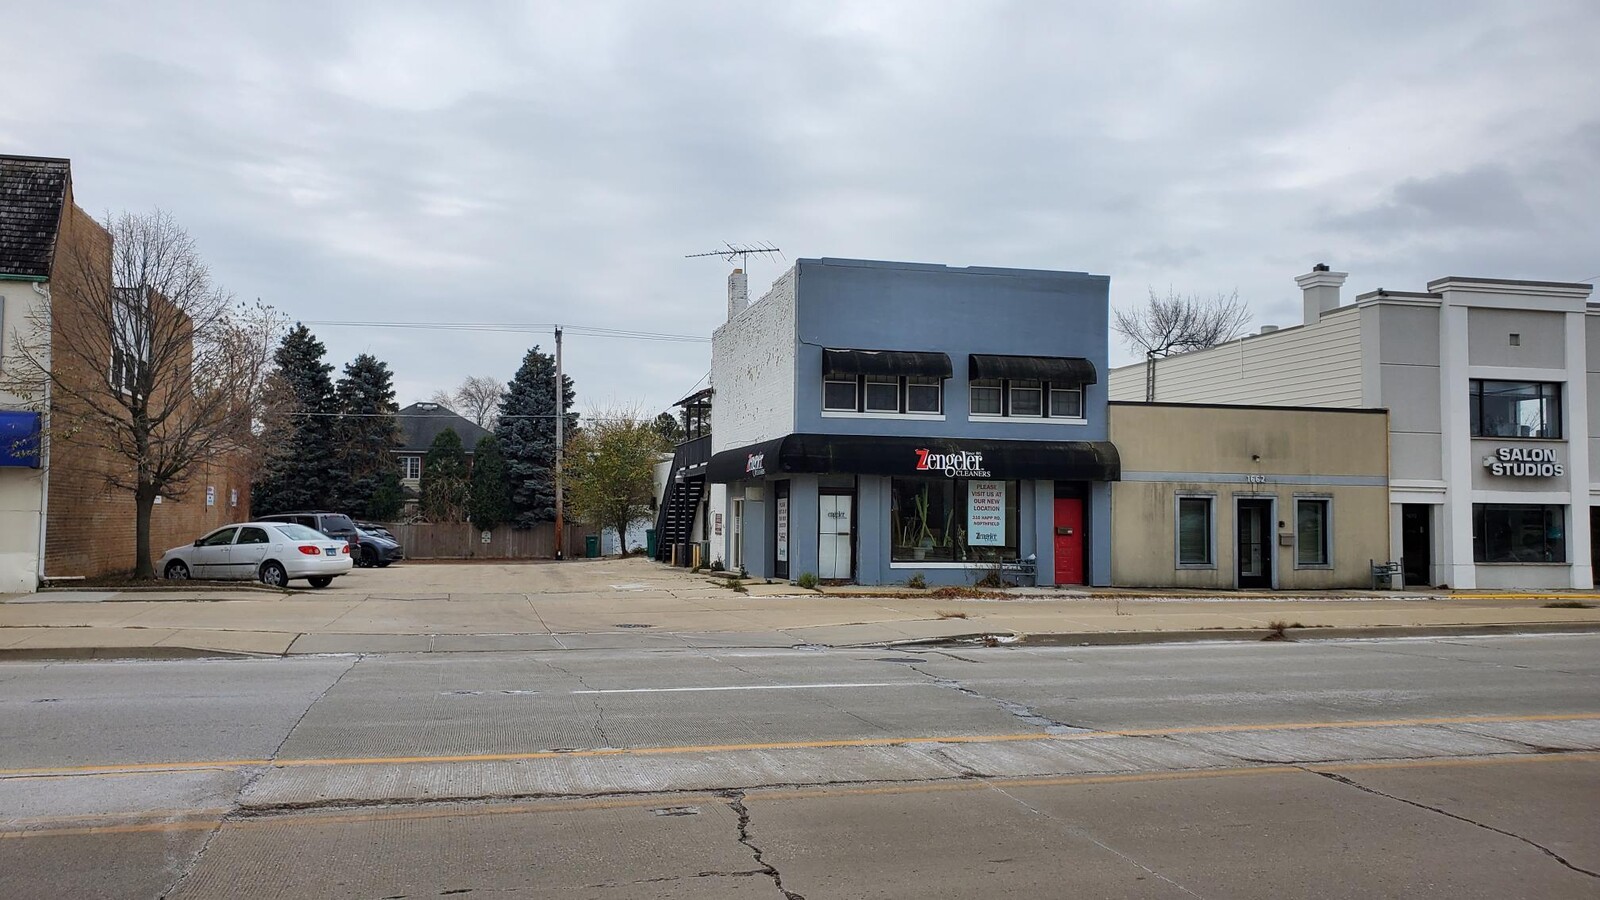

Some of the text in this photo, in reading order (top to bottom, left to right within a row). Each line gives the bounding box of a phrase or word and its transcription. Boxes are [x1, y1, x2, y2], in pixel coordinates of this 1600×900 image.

[1499, 448, 1556, 462] SALON
[915, 448, 983, 477] Zengeler
[1492, 463, 1564, 477] STUDIOS
[1247, 475, 1265, 483] 1662
